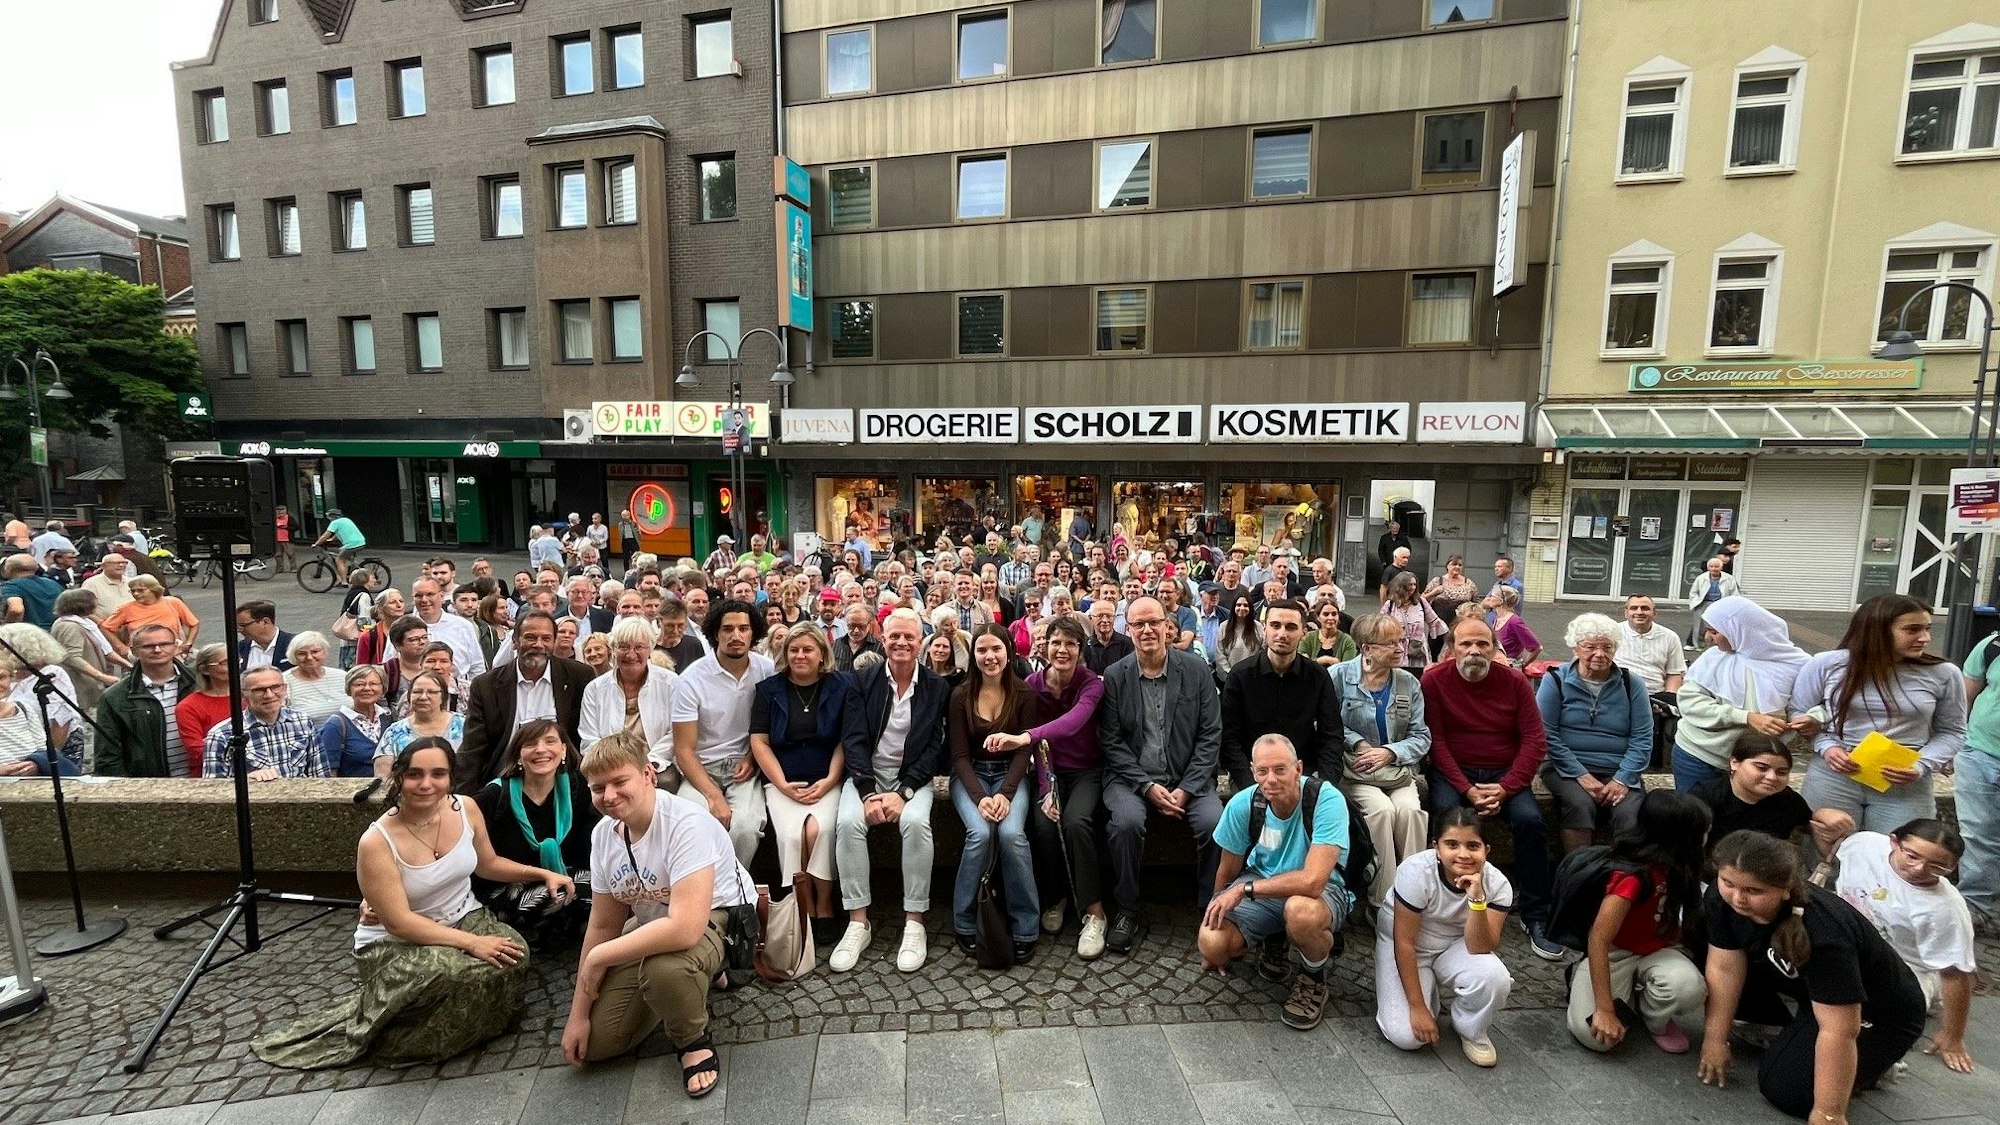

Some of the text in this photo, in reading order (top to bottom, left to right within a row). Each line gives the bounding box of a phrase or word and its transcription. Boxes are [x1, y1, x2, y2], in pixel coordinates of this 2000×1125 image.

[1663, 364, 1914, 382] Restaurant Besseresser
[185, 407, 208, 416] AOK
[626, 403, 661, 417] FAIR
[715, 404, 754, 418] FR
[625, 418, 662, 433] PLAY
[713, 420, 756, 434] PY
[784, 419, 851, 436] JUVENA
[866, 408, 1401, 438] DROGERIE SCHOLZ KOSMETIK
[1421, 413, 1521, 432] REVLON
[239, 442, 260, 455] AOK
[462, 442, 488, 456] AOK
